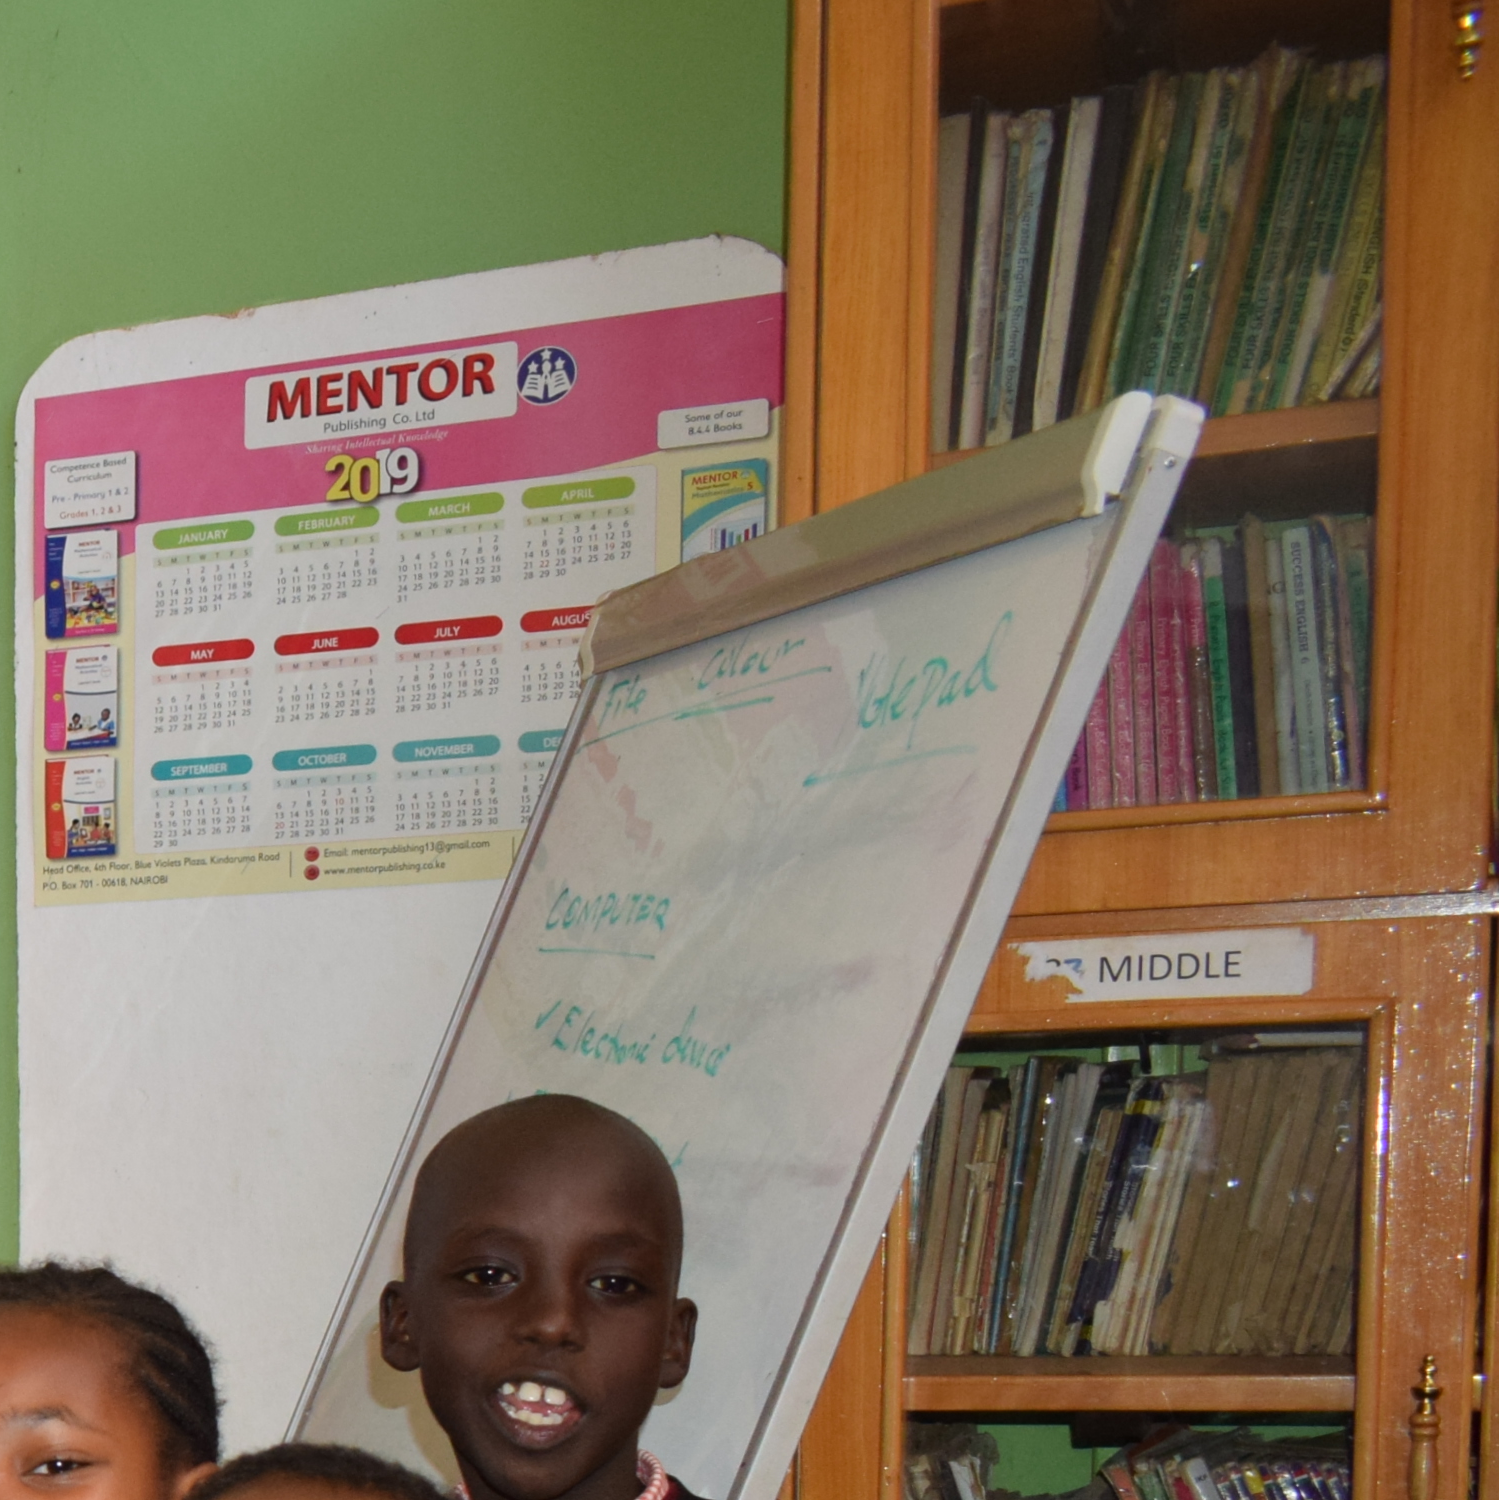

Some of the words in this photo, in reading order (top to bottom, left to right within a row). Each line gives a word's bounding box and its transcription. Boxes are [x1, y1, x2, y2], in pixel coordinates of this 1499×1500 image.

[266, 352, 495, 422] MENTOR
[323, 416, 386, 433] Publishing
[393, 412, 412, 425] Co.
[415, 409, 435, 422] Ltd
[685, 414, 710, 423] Some
[714, 410, 724, 420] of
[726, 410, 743, 418] our
[688, 425, 710, 435] 8.4.4
[714, 422, 743, 432] Books
[305, 441, 343, 455] Sharing
[345, 434, 396, 450] Intellectual
[398, 429, 448, 443] Knowledge
[50, 460, 100, 474] Competence
[103, 457, 126, 467] Based
[67, 471, 112, 483] Curriculum
[325, 447, 419, 502] 2019
[692, 471, 738, 485] MENTOR
[74, 491, 105, 503] Primary
[115, 488, 121, 496] &
[124, 487, 129, 495] 2
[561, 488, 594, 501] APRIL
[60, 510, 88, 520] Grades
[108, 506, 114, 514] &
[428, 502, 470, 516] MARCH
[298, 515, 355, 531] FEBRUARY
[178, 529, 228, 544] JANUARY
[1290, 541, 1304, 596] SUCCESS
[434, 626, 461, 638] JULY
[1295, 599, 1309, 652] ENGLISH
[312, 638, 338, 650] JUNE
[191, 649, 214, 660] MAY
[415, 744, 474, 757] NOVEMBER
[298, 753, 346, 766] OCTOBER
[171, 763, 227, 777] SEPTEMBER
[351, 840, 490, 856] mentorpublishing13@gmail.com
[43, 865, 64, 876] Head
[94, 862, 106, 872] 4th
[135, 859, 152, 869] Blue
[154, 857, 182, 868] Violets
[210, 853, 255, 865] Kindaruma
[258, 852, 280, 862] Road
[324, 861, 446, 876] www.mentorpublishing.co.ke
[62, 880, 76, 890] Box
[79, 879, 93, 889] 701
[130, 876, 168, 886] NAIROBI
[545, 888, 670, 931] COMPUTER
[1098, 949, 1242, 984] MIDDLE
